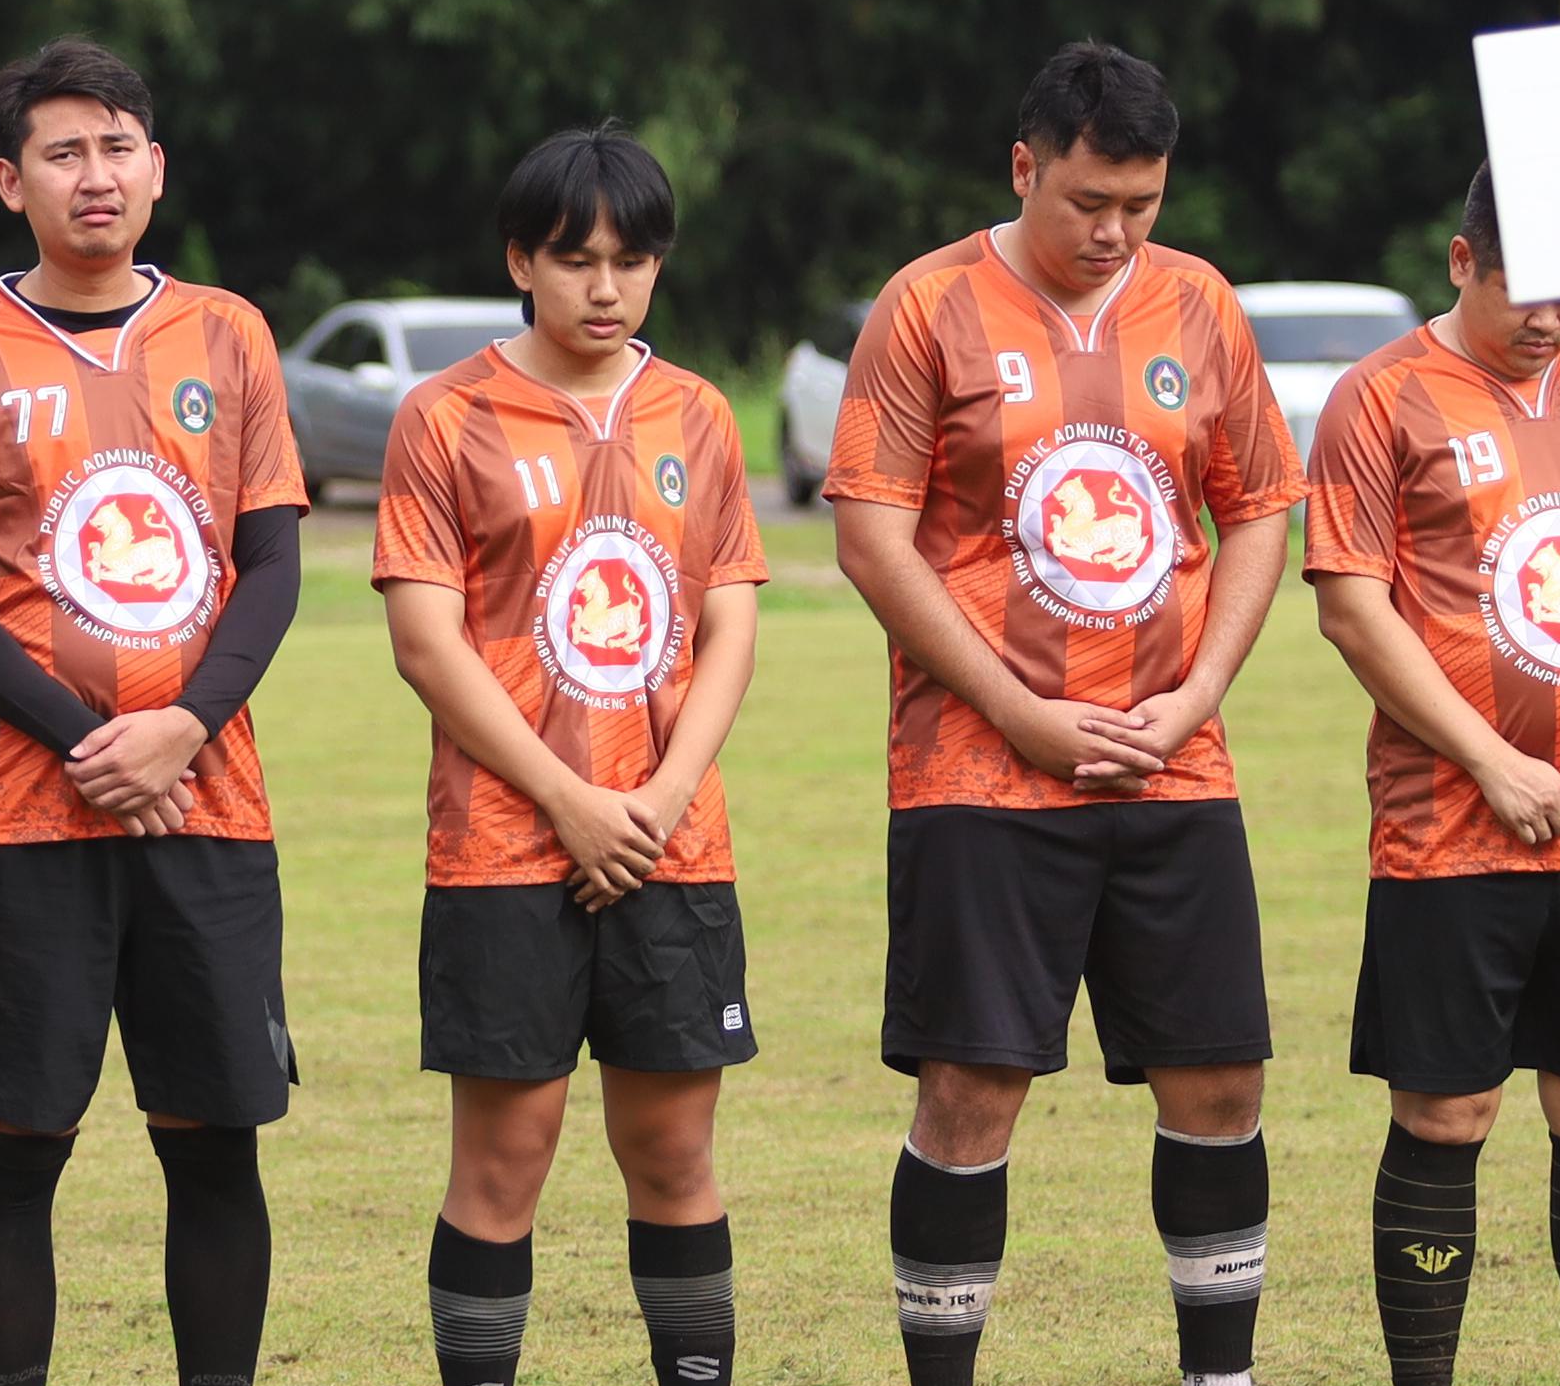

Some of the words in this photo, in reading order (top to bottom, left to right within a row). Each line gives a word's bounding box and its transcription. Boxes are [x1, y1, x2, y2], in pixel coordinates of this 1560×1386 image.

[996, 351, 1034, 404] 9
[1, 384, 68, 444] 77
[514, 454, 562, 509] 11
[1004, 438, 1051, 500] PUBLIC
[1053, 422, 1177, 502] ADMINISTRATION
[1448, 430, 1506, 487] 19
[40, 470, 81, 535] PUBLIC
[82, 448, 214, 526] ADMINISTRATION
[536, 537, 573, 598] PUBLIC
[574, 514, 680, 594] ADMINISTRATION
[1478, 514, 1517, 575] PUBLIC
[73, 613, 161, 650] KAMPHAENG
[168, 620, 198, 646] PHET
[1029, 586, 1115, 630] KAMPHAENG
[1125, 604, 1156, 626] PHET
[648, 614, 684, 691] UNIVERSITY
[1213, 1256, 1265, 1276] NUMBE
[947, 1291, 976, 1307] TEN
